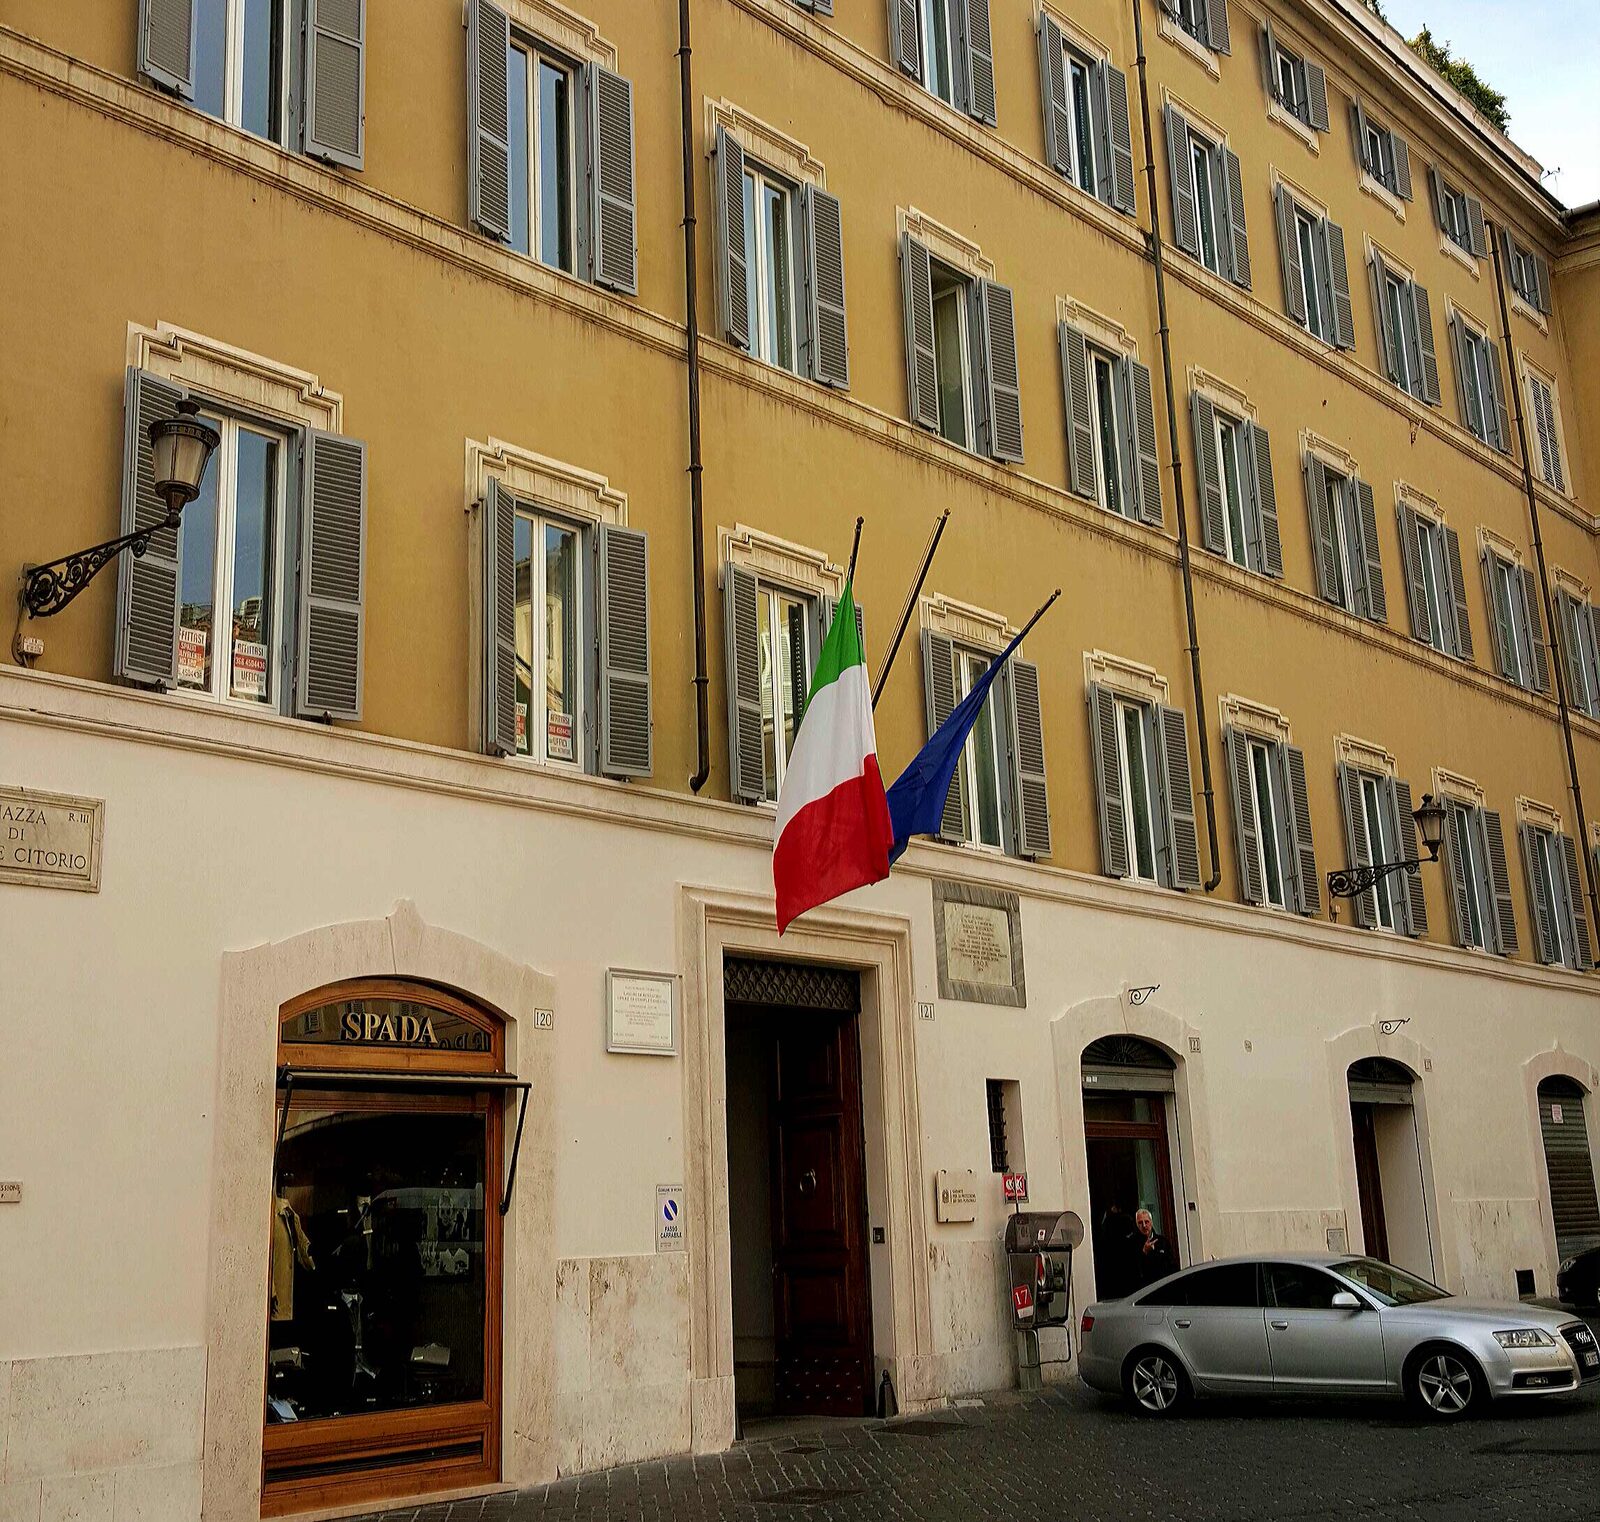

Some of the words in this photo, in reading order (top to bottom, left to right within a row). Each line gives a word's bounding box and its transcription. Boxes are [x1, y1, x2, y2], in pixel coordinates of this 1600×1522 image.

[8, 827, 24, 841] DI
[14, 848, 86, 869] CITORIO
[536, 1011, 552, 1027] 120
[920, 1004, 933, 1019] 121
[341, 1012, 438, 1044] SPADA
[1014, 1289, 1029, 1305] 17
